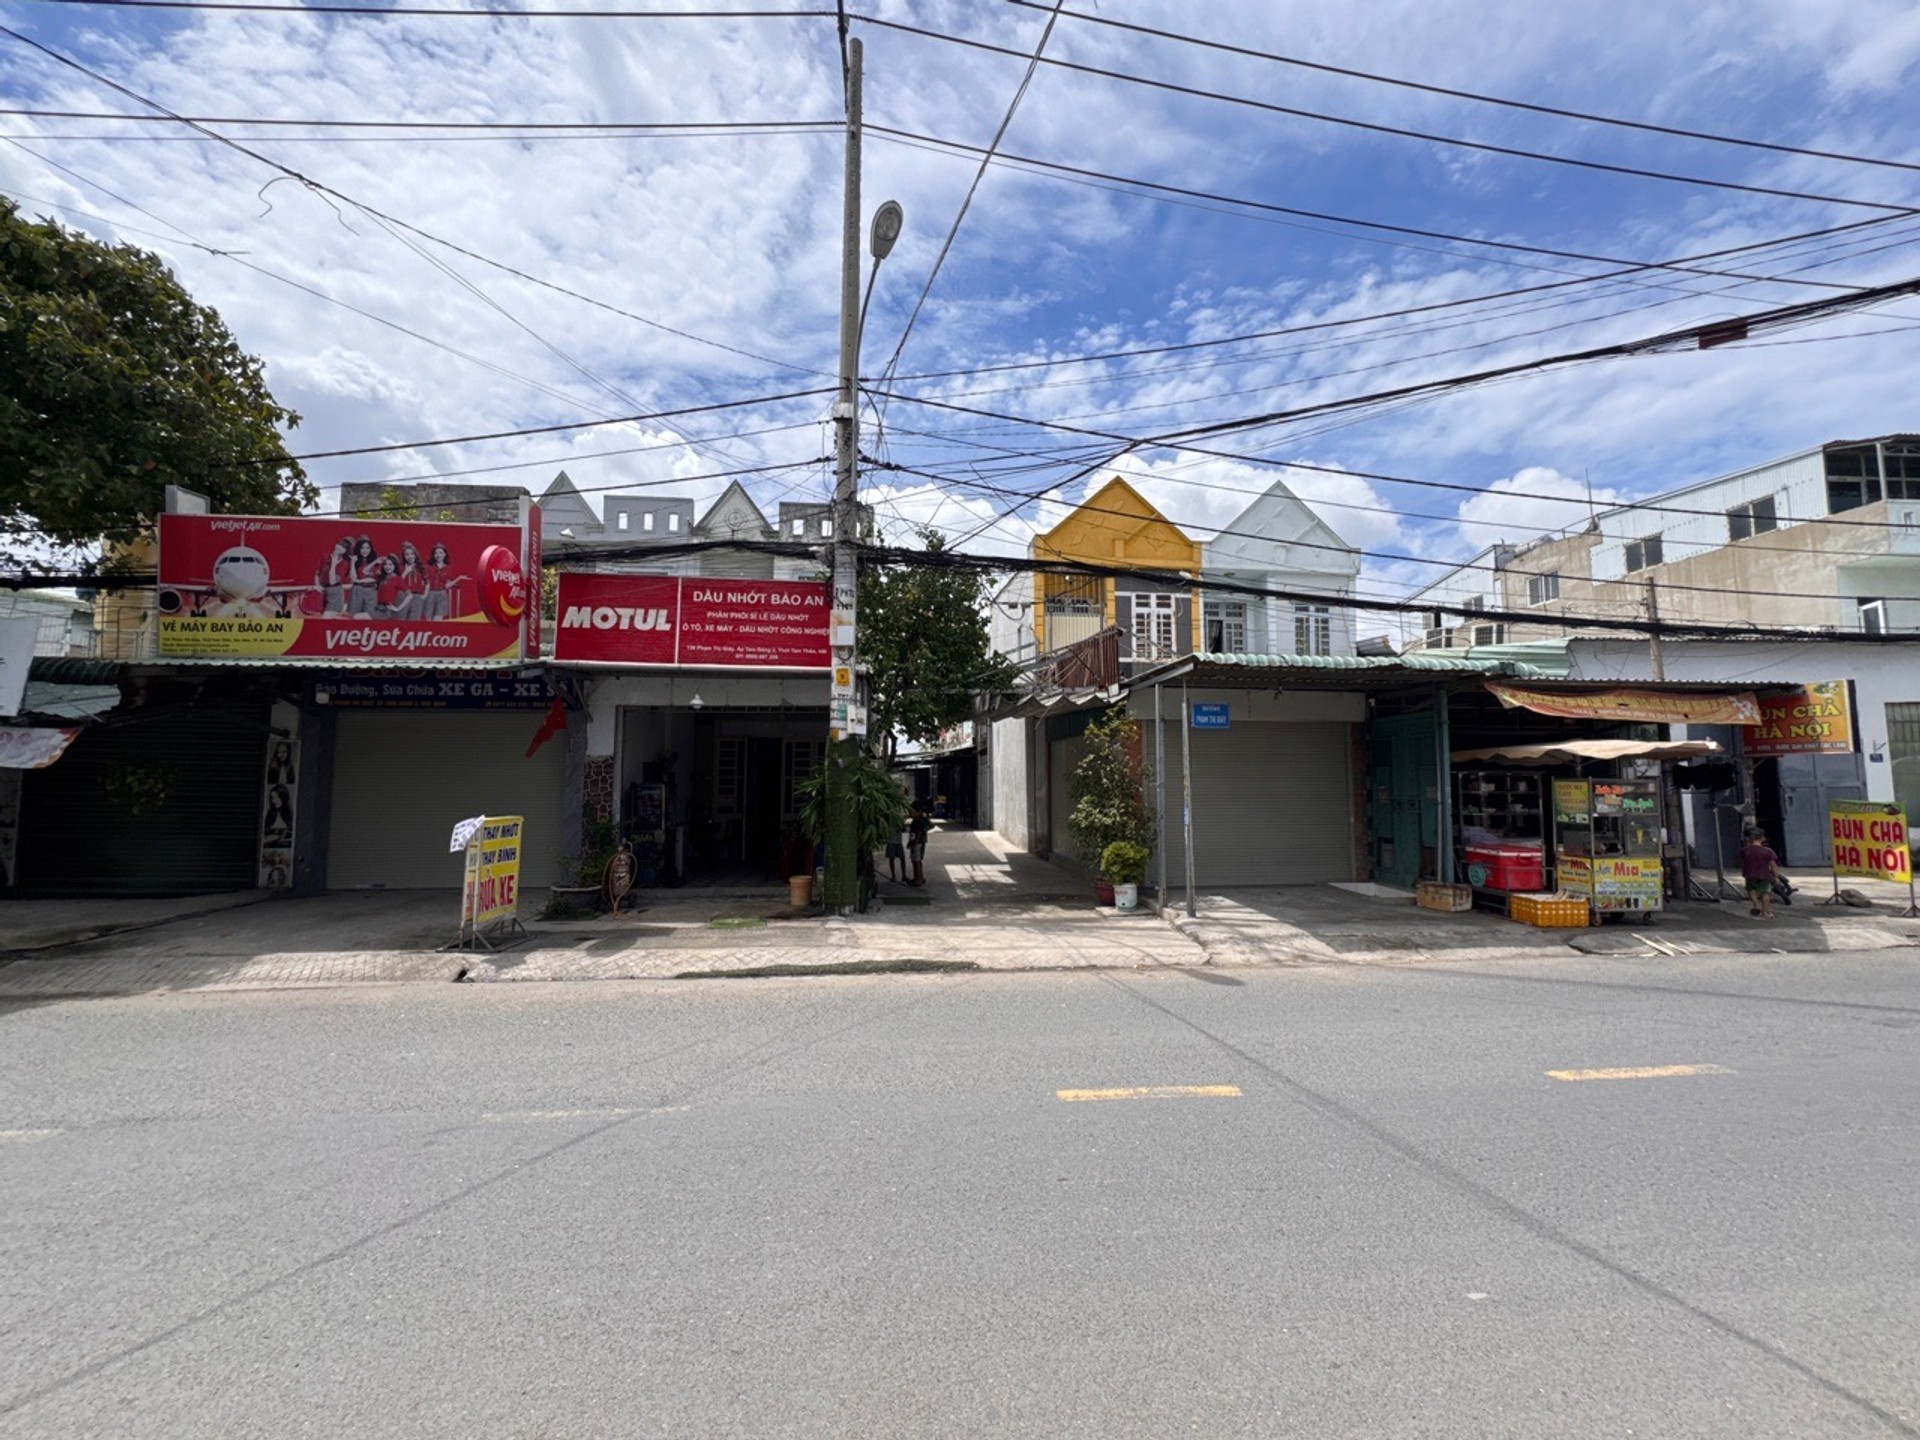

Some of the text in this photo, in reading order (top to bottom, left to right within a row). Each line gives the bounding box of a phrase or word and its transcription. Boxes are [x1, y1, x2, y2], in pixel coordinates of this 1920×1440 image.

[804, 595, 824, 606] AN
[180, 619, 207, 633] MÁY
[211, 622, 235, 633] BAY
[238, 618, 263, 633] BẢO
[267, 623, 283, 633] AN
[561, 606, 672, 631] MOTUL
[438, 683, 465, 696] XE
[470, 683, 494, 696] GA
[514, 683, 540, 697] XE
[1759, 706, 1786, 720] ÚN
[1753, 719, 1832, 740] HÀ NỘI
[1835, 841, 1861, 867] HÀ
[500, 875, 515, 907] XE
